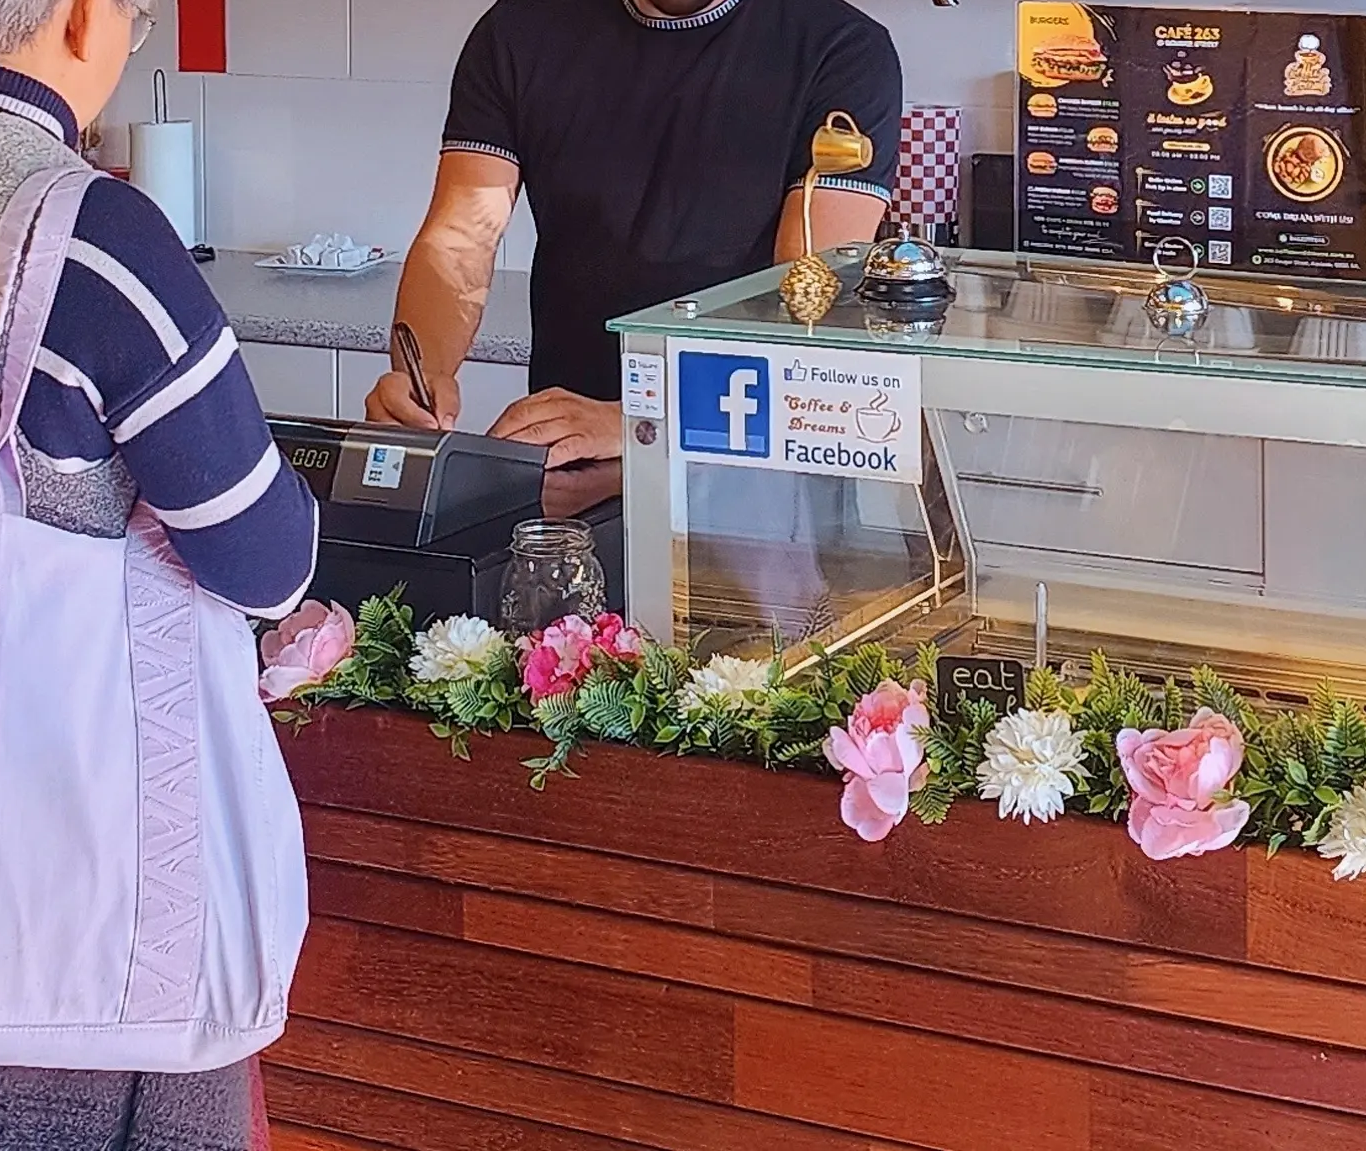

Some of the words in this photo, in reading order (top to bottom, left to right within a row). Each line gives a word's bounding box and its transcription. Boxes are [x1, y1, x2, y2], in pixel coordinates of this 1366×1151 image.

[1155, 23, 1191, 39] CAFÉ
[1194, 28, 1221, 40] 263
[811, 368, 857, 384] Follow
[863, 376, 878, 386] us
[884, 377, 900, 389] on
[784, 395, 833, 412] Coffee
[840, 401, 851, 413] &
[788, 416, 846, 434] Dreams
[785, 439, 897, 471] Facebook
[953, 661, 1015, 690] eat
